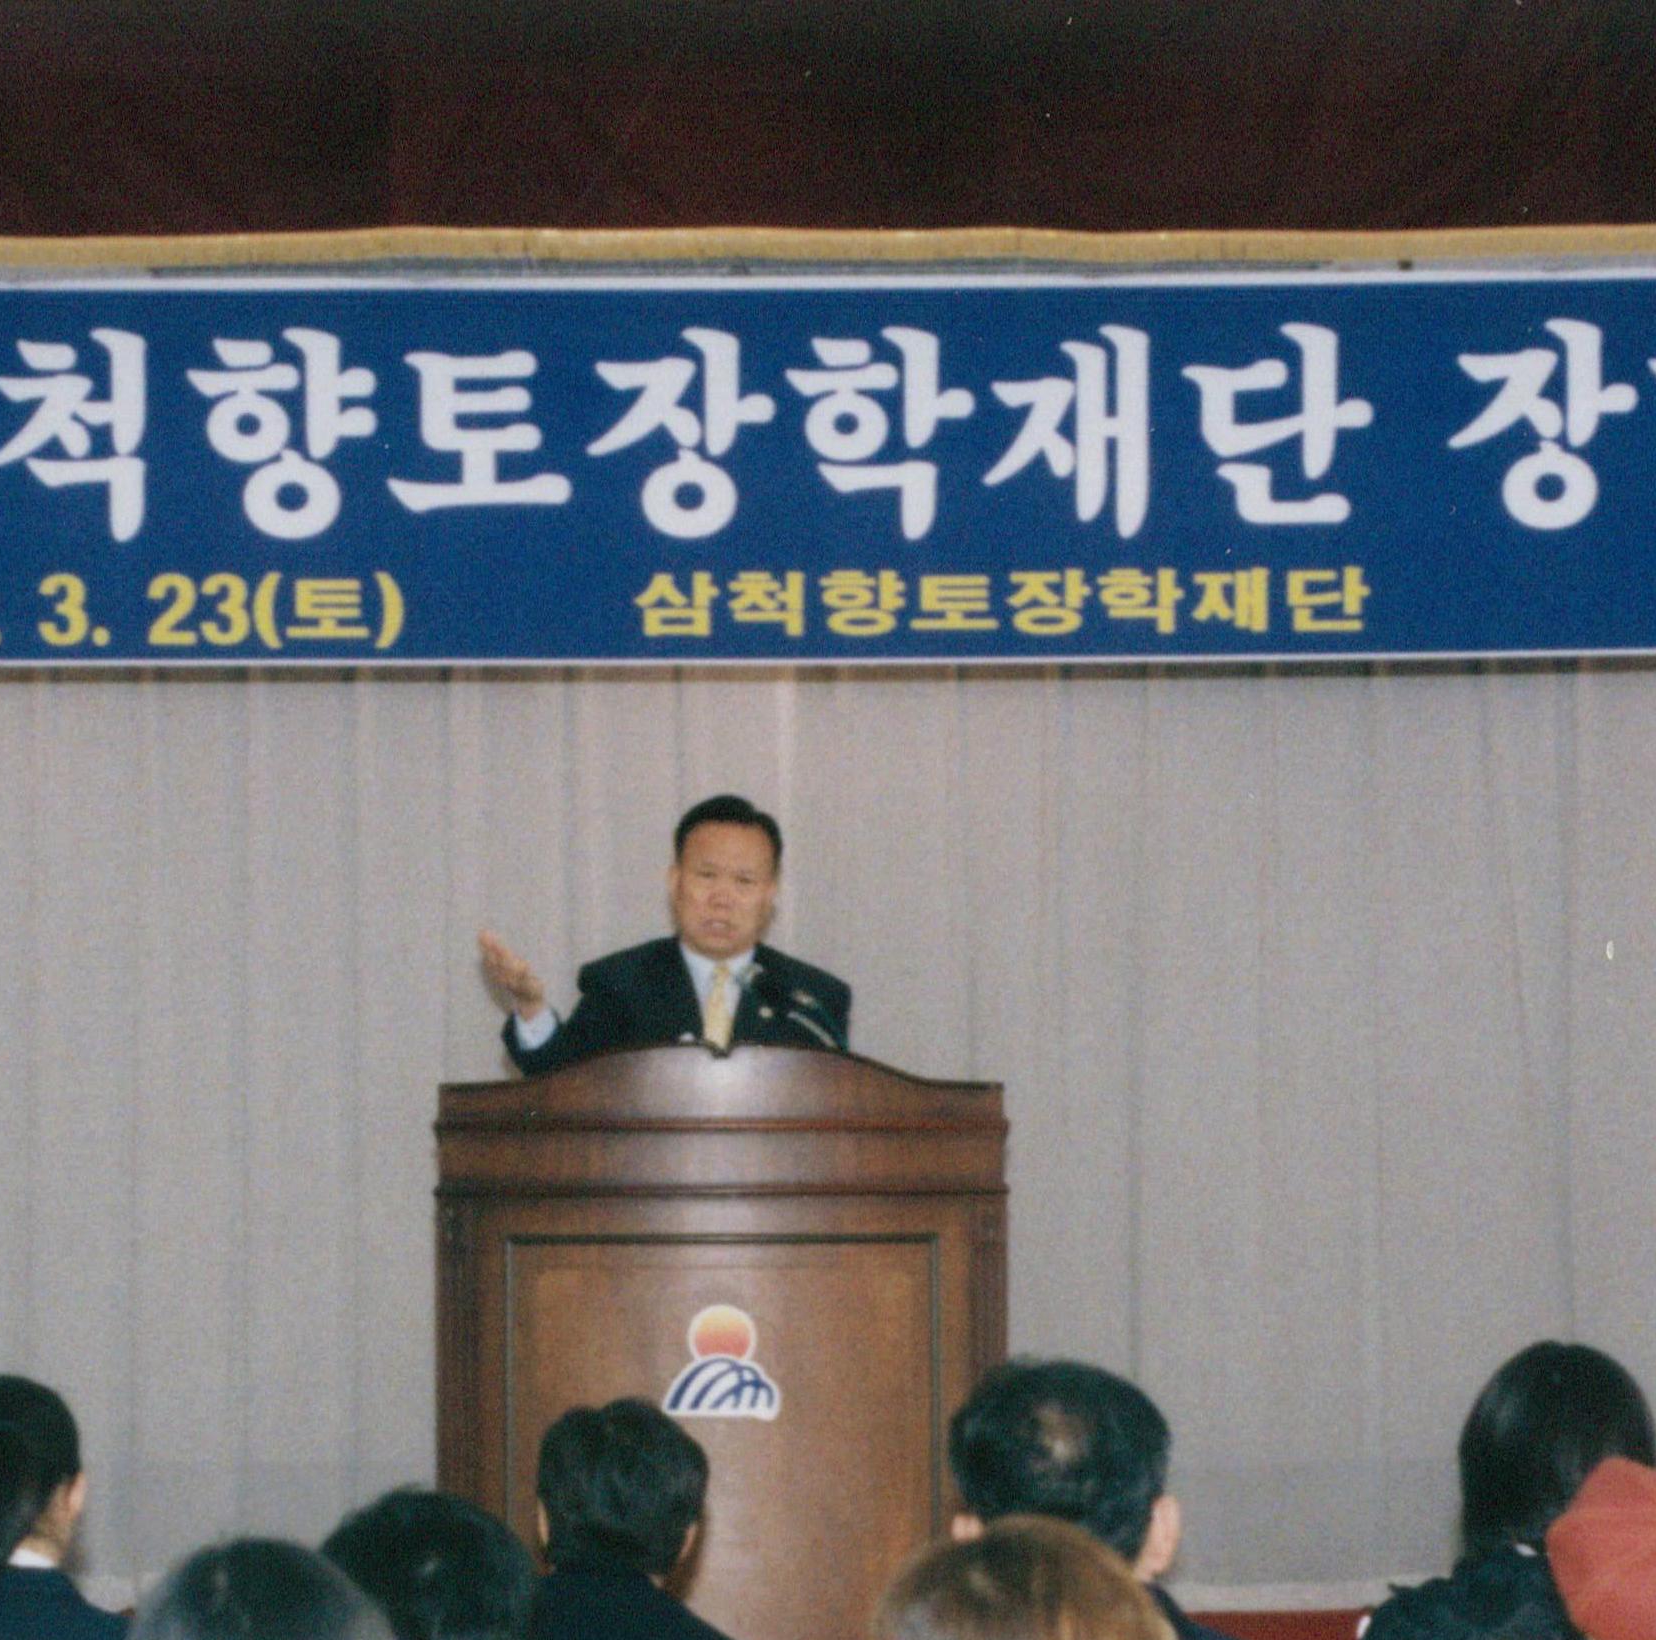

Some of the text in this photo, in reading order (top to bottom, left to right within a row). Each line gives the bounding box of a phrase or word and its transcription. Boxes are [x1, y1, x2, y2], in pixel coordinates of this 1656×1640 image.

[38, 573, 110, 647] 3.
[147, 571, 405, 650] 23(토)
[634, 565, 1370, 638] 삼척향토장학재단
